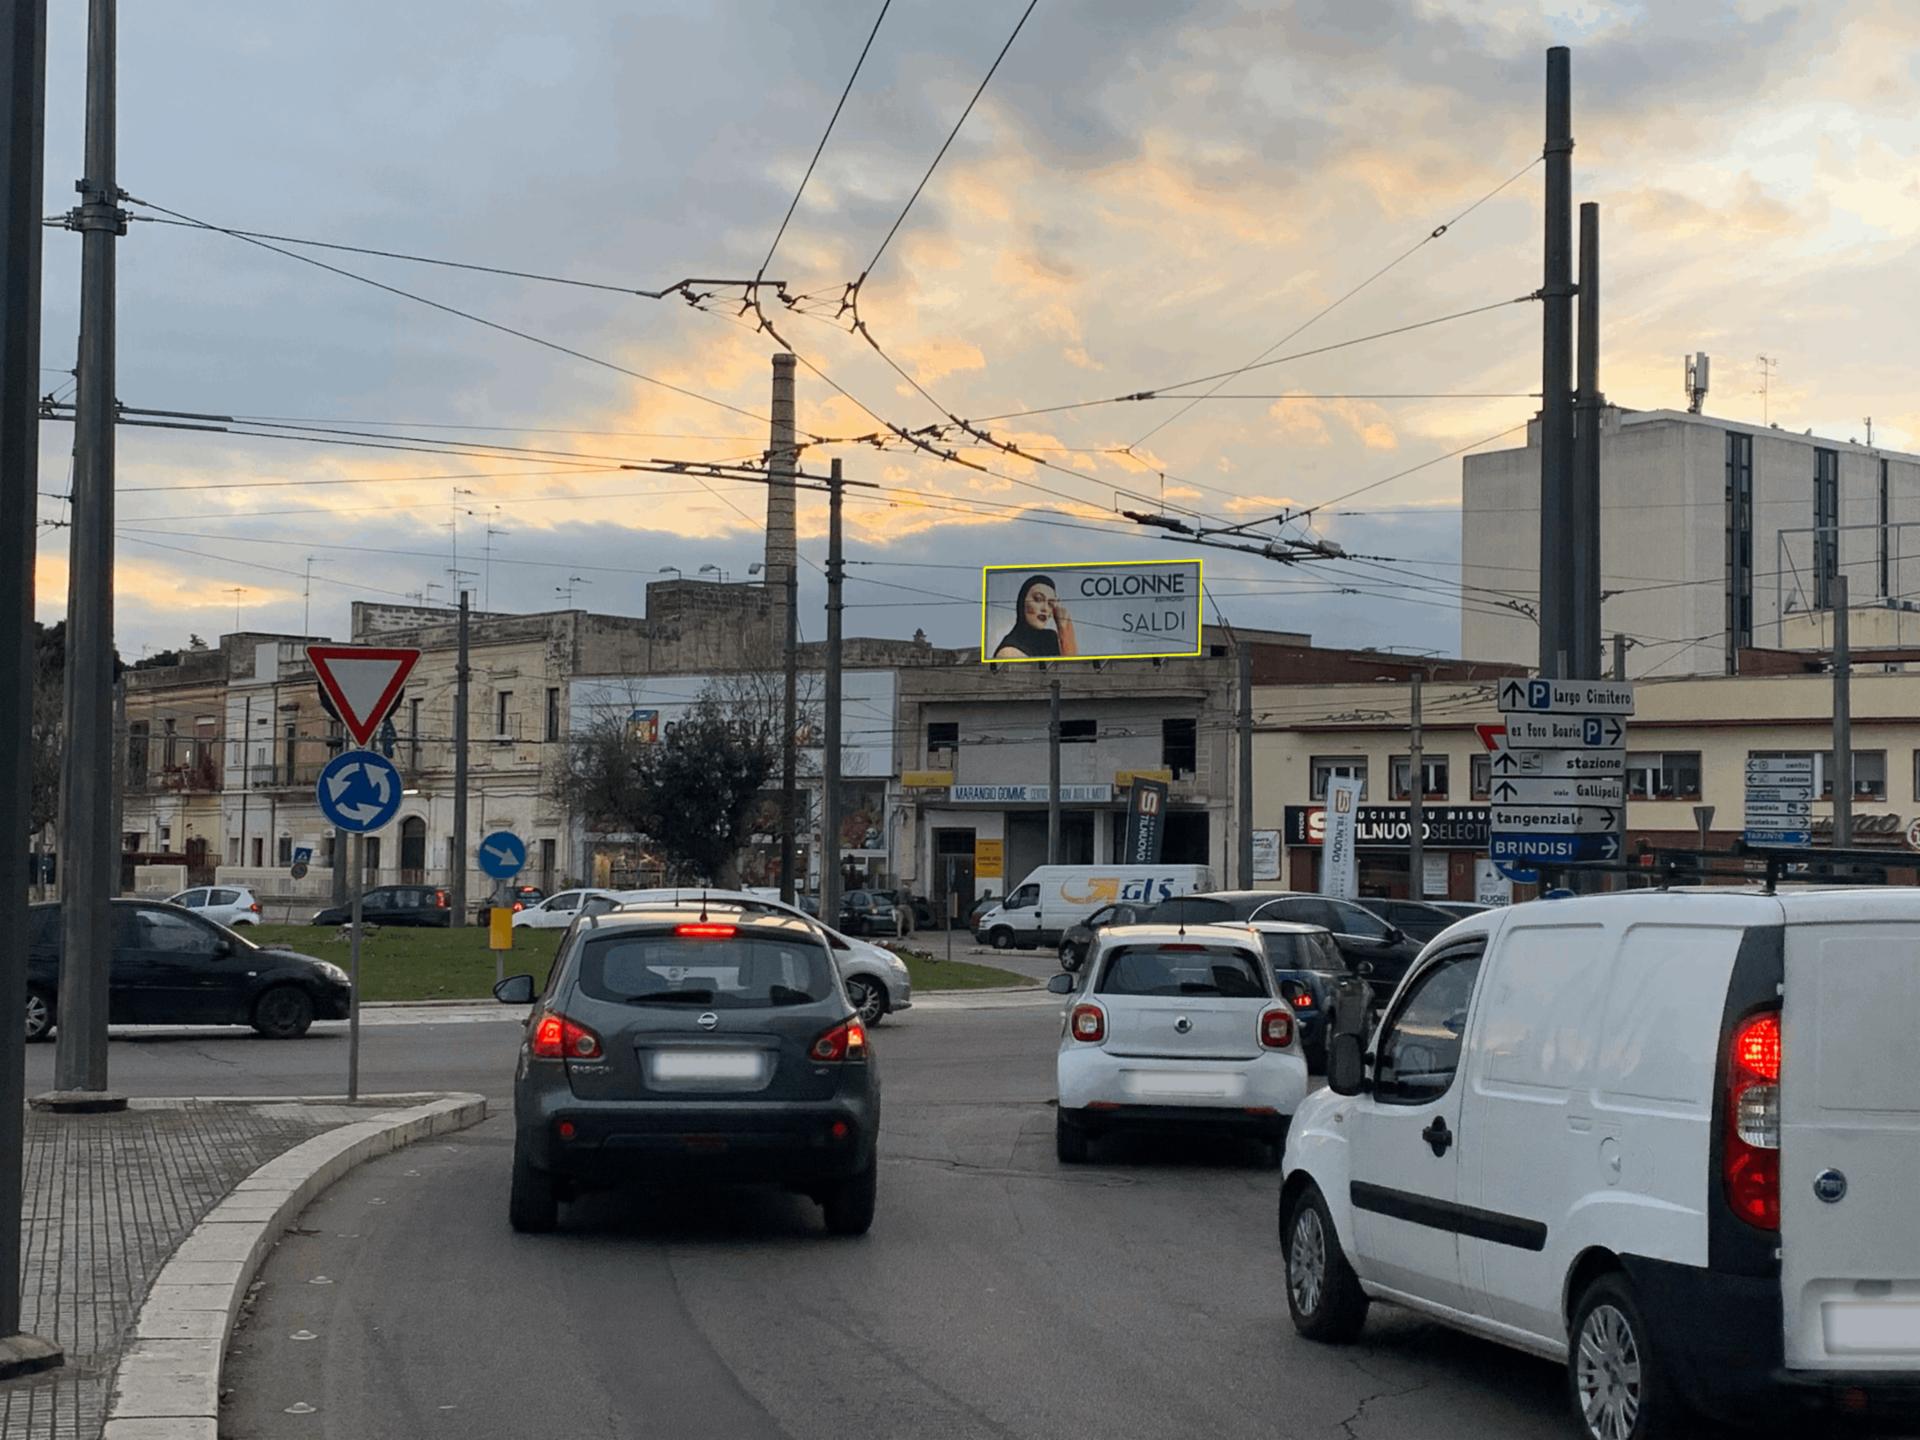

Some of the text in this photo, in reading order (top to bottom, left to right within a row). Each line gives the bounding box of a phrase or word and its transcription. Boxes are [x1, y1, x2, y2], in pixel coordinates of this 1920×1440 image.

[1081, 573, 1185, 597] COLONNE
[1122, 611, 1185, 632] SALDI
[1587, 688, 1631, 704] Cimitero
[1511, 726, 1522, 737] ex
[1527, 723, 1547, 737] Foro
[1552, 722, 1581, 738] Boario
[1566, 756, 1621, 769] stazione
[998, 786, 1026, 800] GOMME
[1576, 784, 1620, 799] Gallipoli
[1358, 811, 1406, 820] UCINE
[1447, 811, 1492, 820] MISU
[1496, 811, 1584, 826] tangenziale
[1430, 823, 1492, 839] SELECTI
[1495, 841, 1573, 855] BRINDISI
[1121, 878, 1175, 903] GLS
